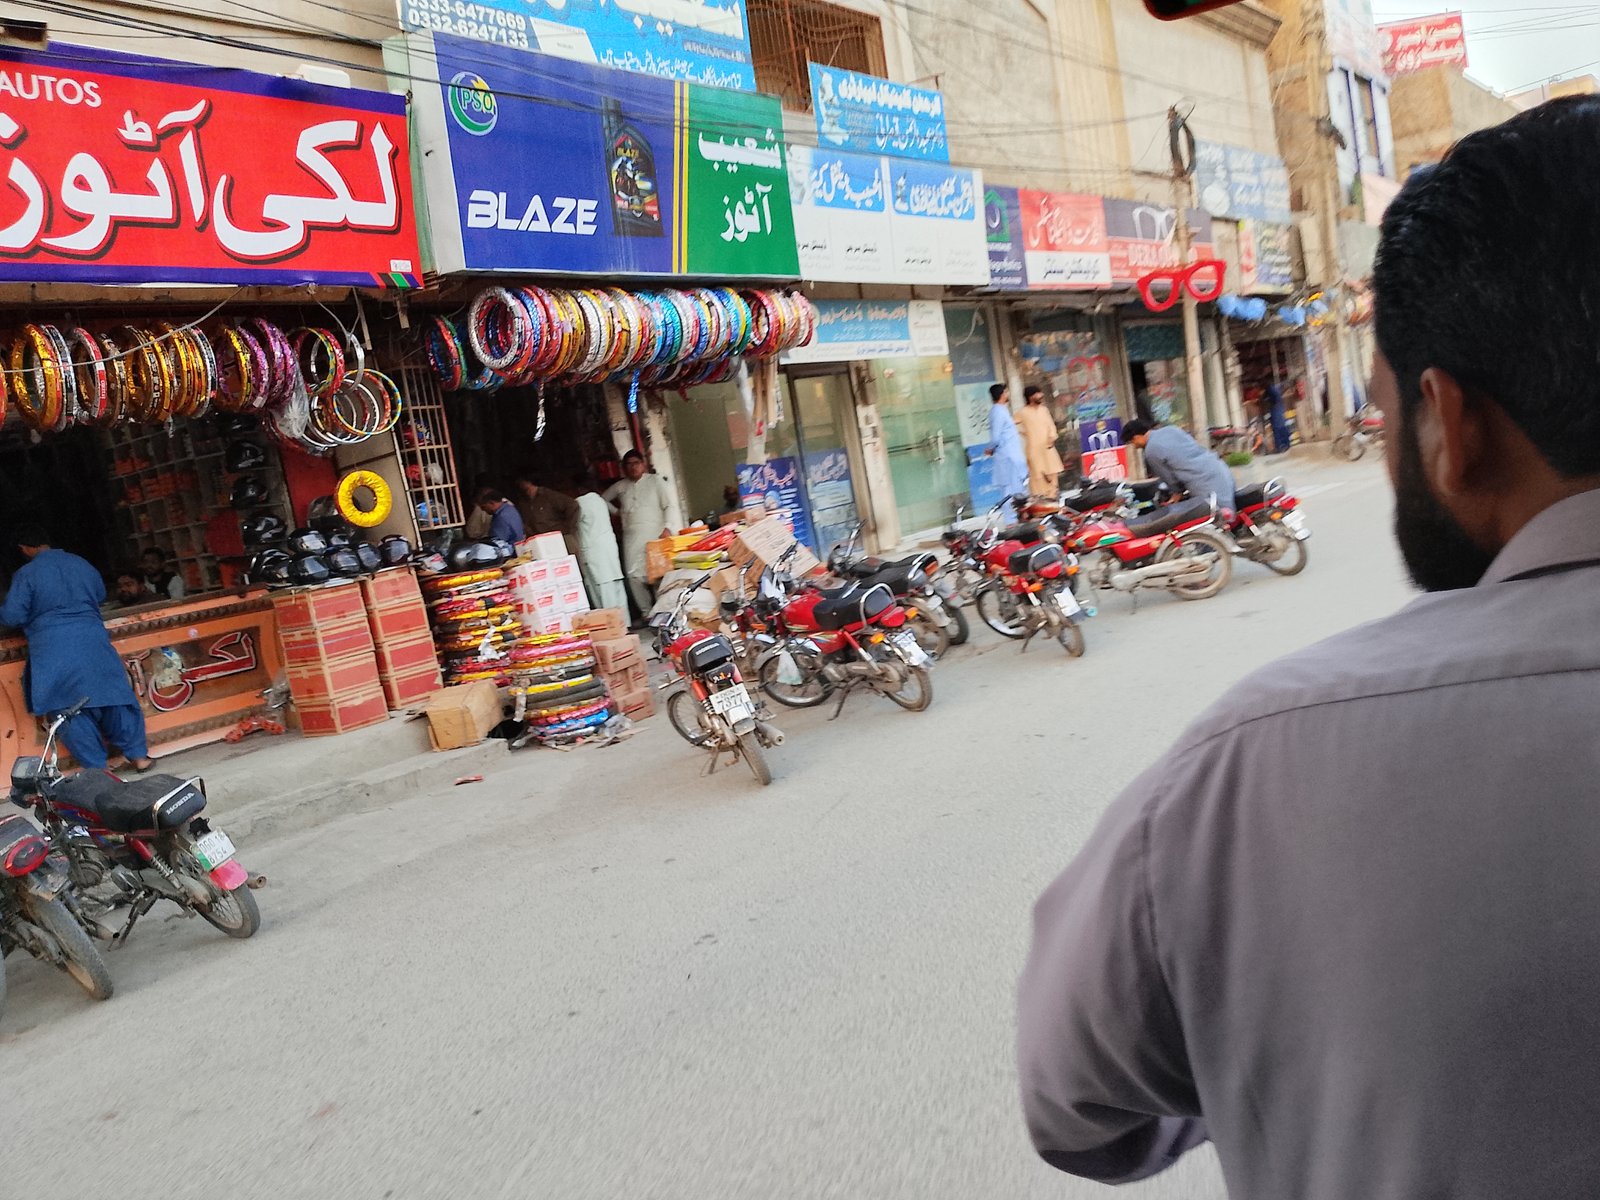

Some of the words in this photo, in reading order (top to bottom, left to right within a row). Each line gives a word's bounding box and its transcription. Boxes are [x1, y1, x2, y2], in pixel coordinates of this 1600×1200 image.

[407, 9, 529, 49] 0332-6247133
[0, 72, 102, 108] AUTOS
[461, 88, 495, 115] PSO
[698, 128, 783, 172] شعیب
[0, 98, 208, 252] آٹوز
[212, 119, 400, 258] لکی
[467, 189, 599, 236] BLAZE
[719, 183, 773, 243] آٹوز
[165, 792, 195, 816] HONDA
